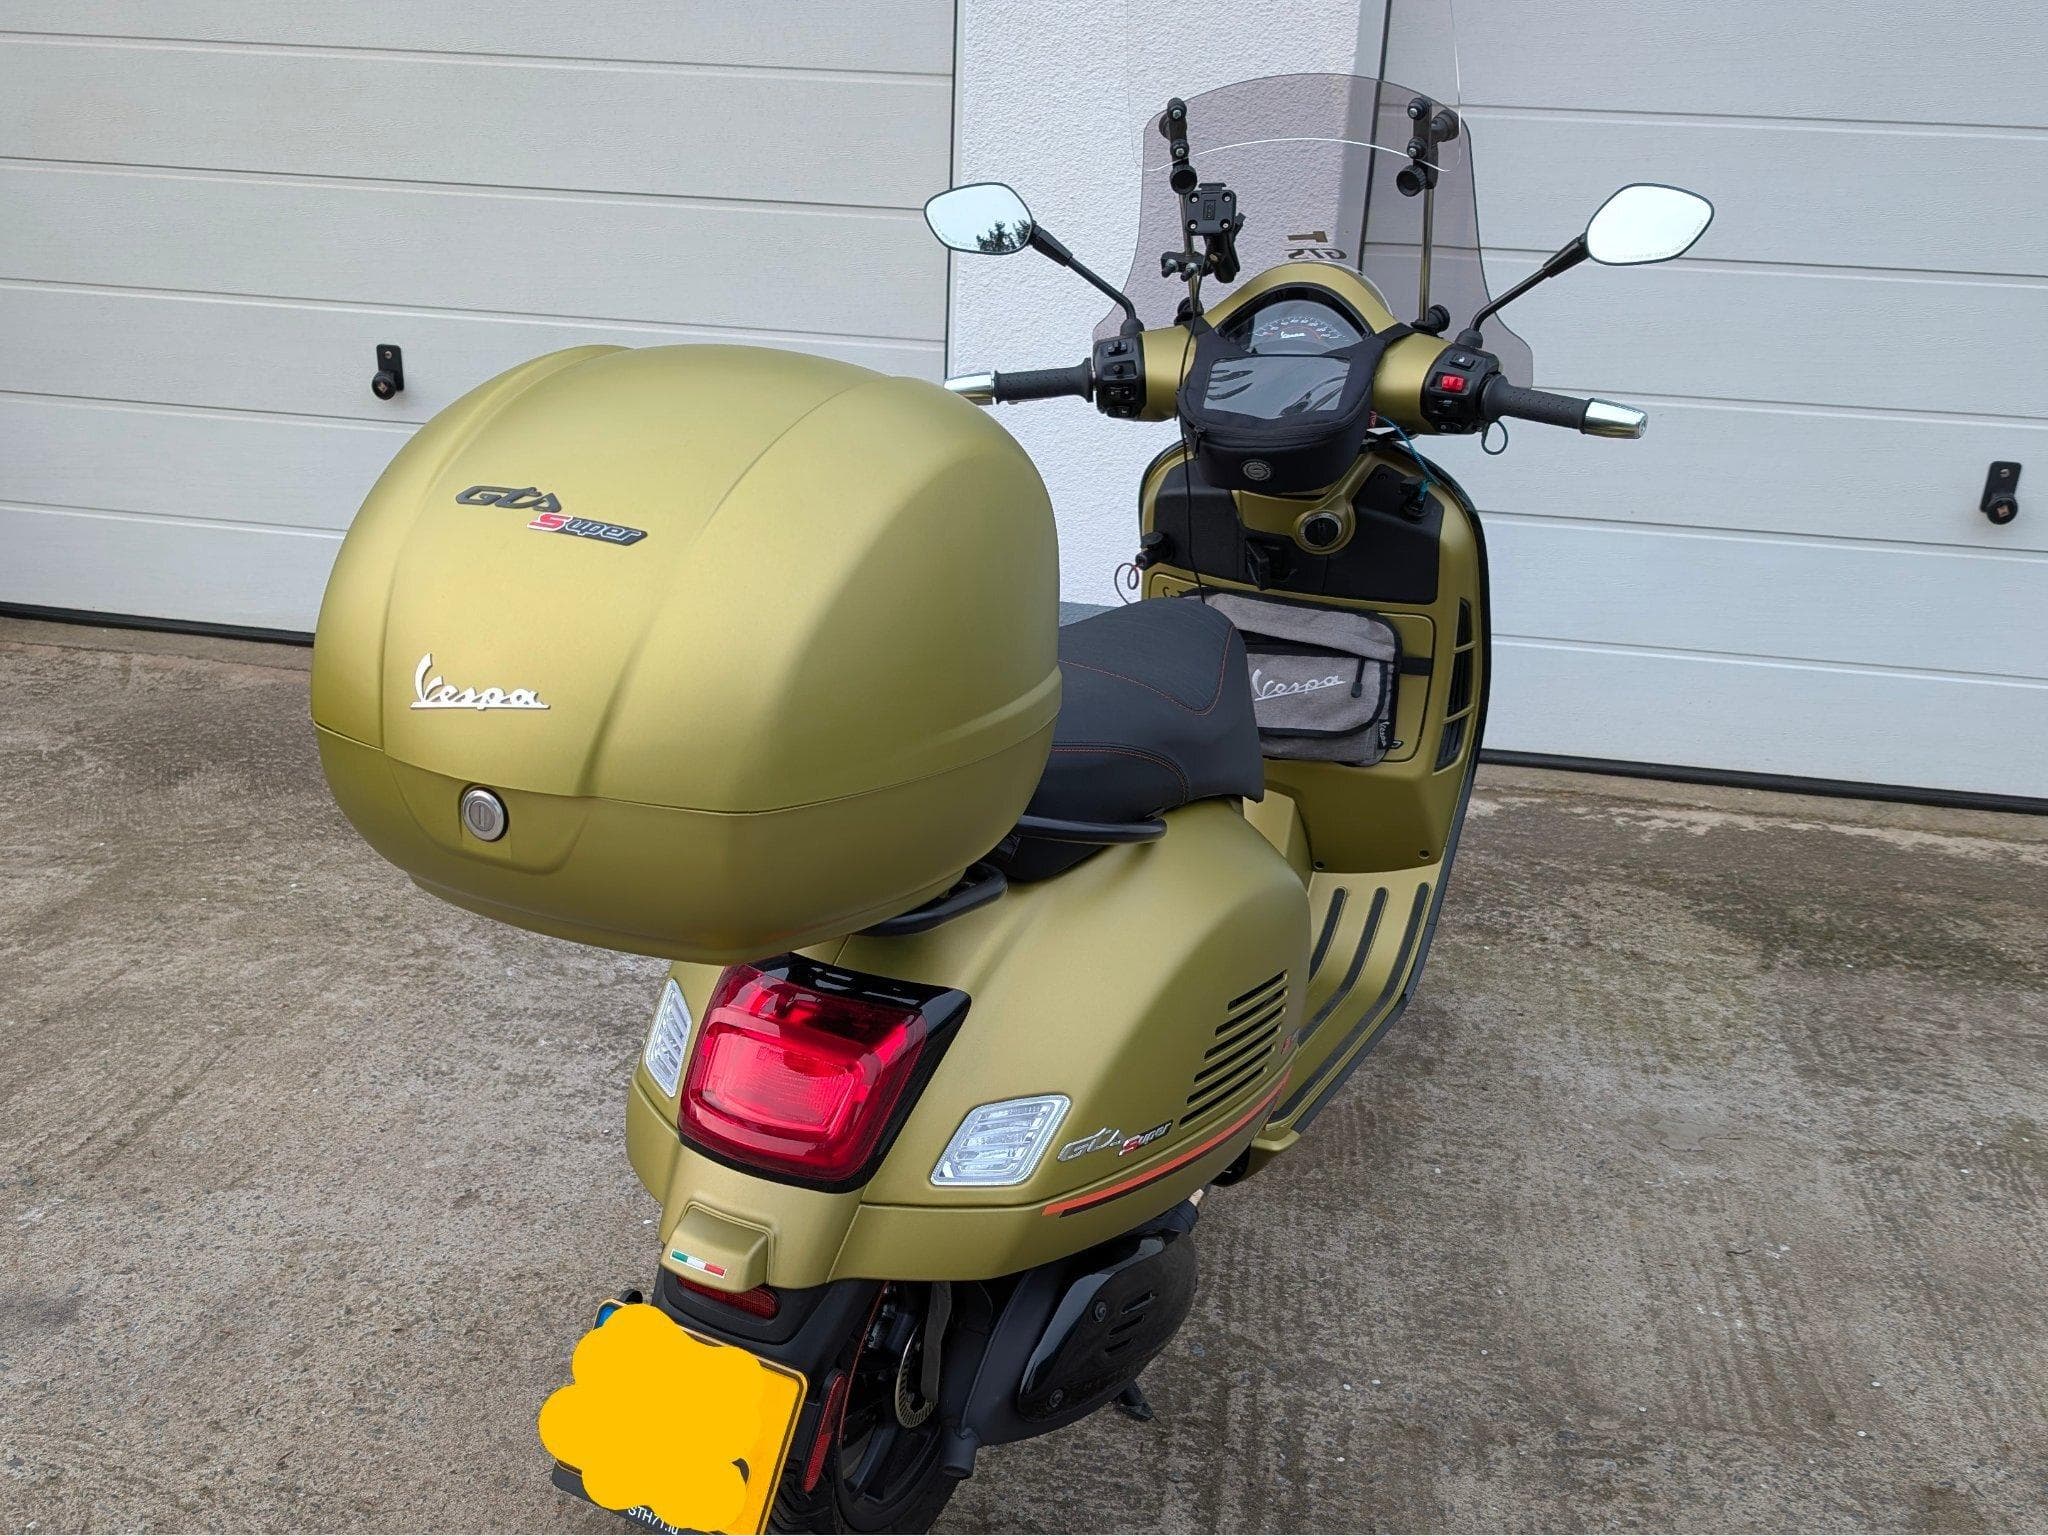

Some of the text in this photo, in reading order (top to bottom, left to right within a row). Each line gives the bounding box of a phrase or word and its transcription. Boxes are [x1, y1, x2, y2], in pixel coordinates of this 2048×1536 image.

[526, 512, 643, 544] Super
[409, 652, 551, 711] Vespa
[1251, 668, 1347, 701] Vespa
